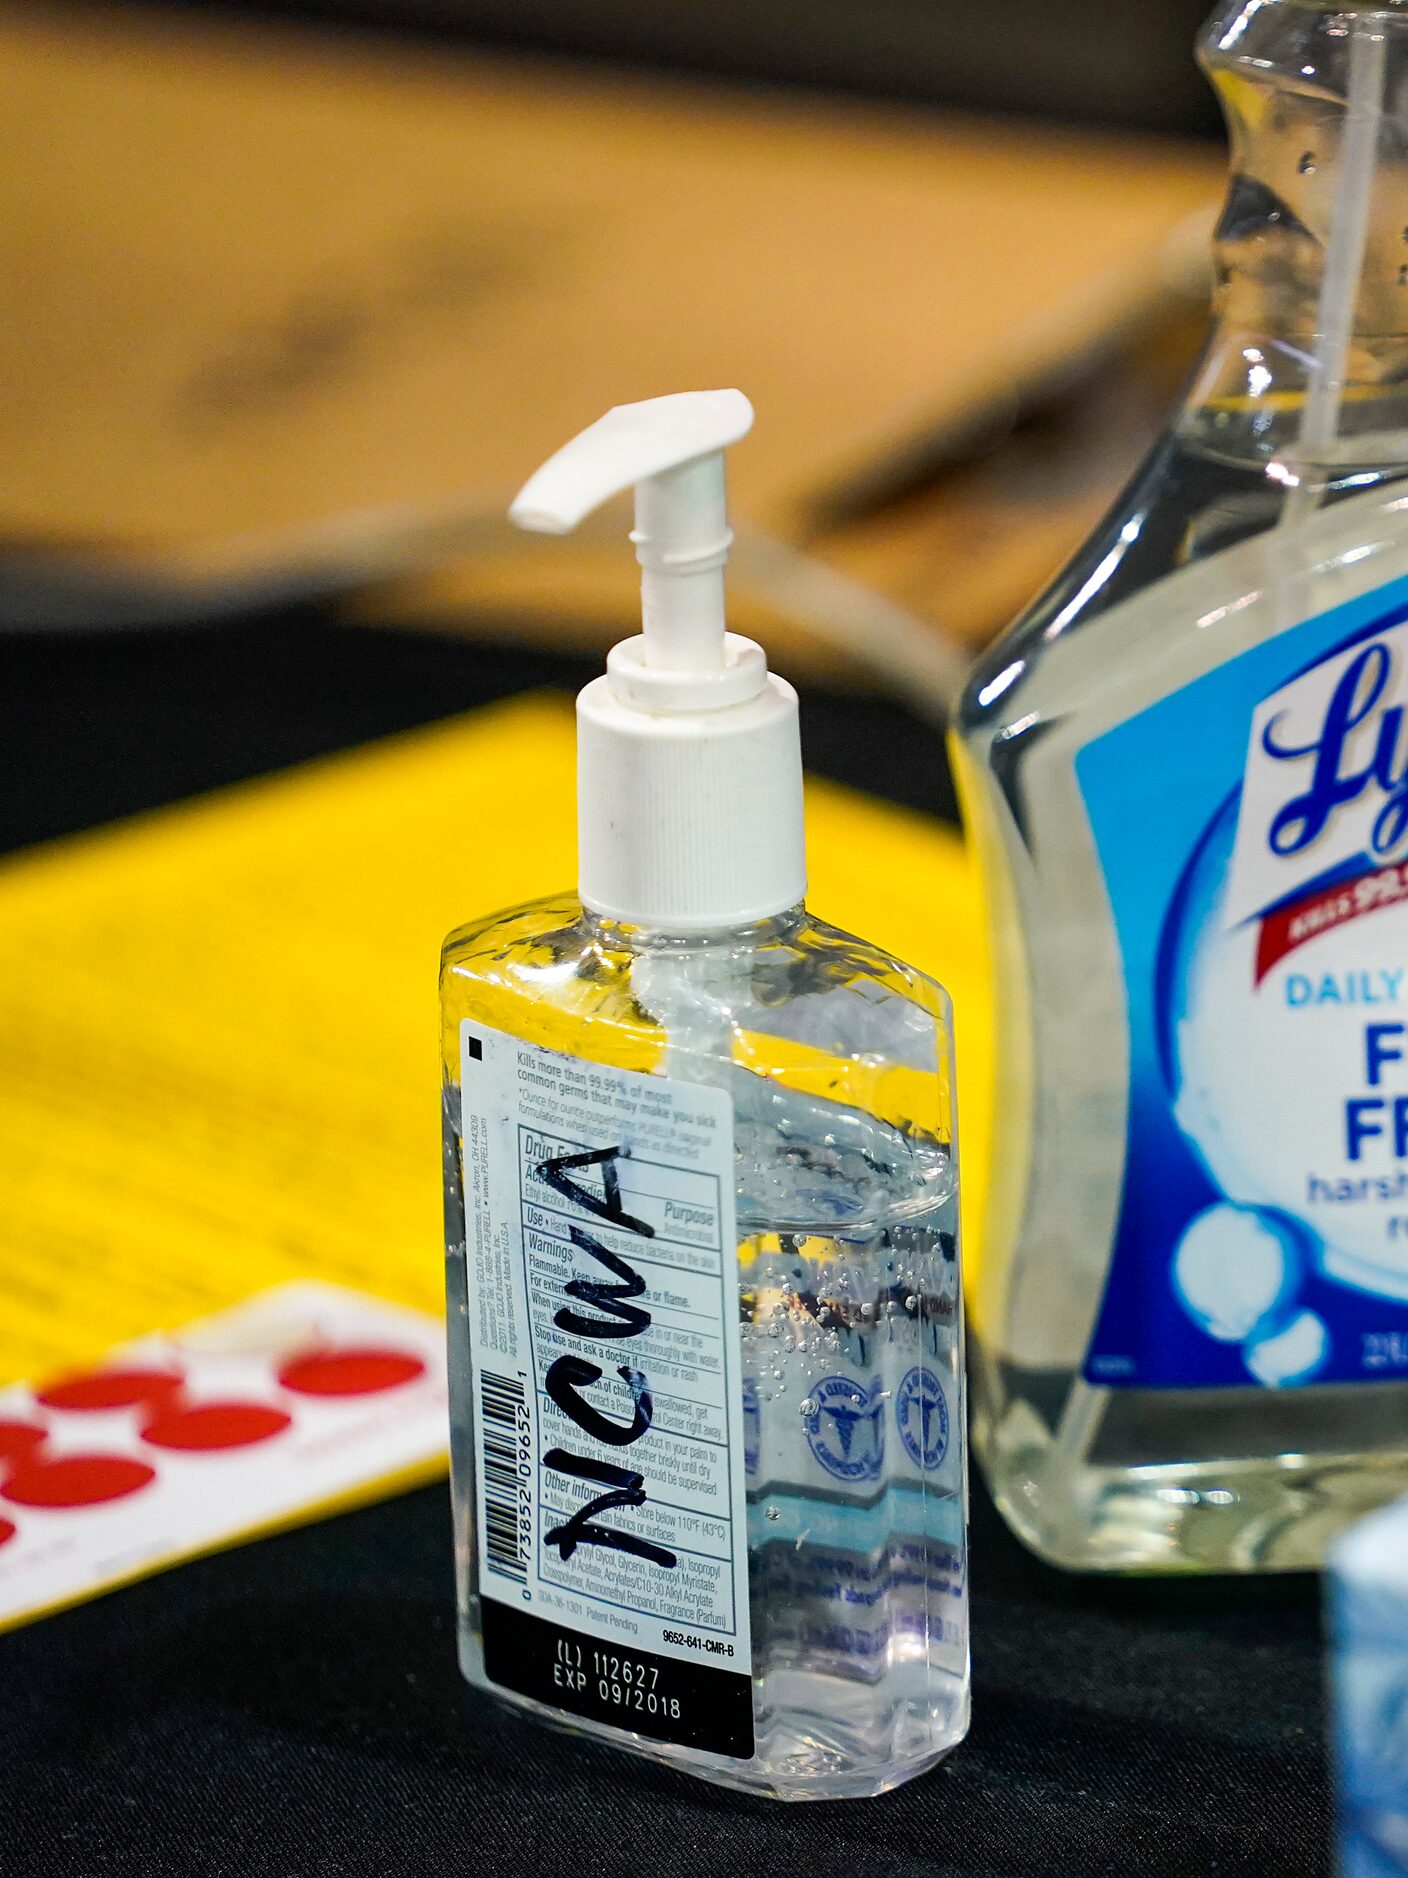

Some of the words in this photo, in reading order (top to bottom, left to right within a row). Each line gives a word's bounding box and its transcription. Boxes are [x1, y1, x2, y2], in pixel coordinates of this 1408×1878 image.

[1285, 966, 1401, 1010] DAILY
[517, 1051, 535, 1069] Kills
[537, 1062, 561, 1078] more
[564, 1067, 585, 1085] than
[631, 1084, 641, 1098] of
[517, 1068, 554, 1089] common
[559, 1081, 588, 1101] germs
[590, 1089, 612, 1106] that
[614, 1096, 636, 1115] may
[640, 1100, 669, 1119] make
[672, 1108, 692, 1127] you
[696, 1111, 715, 1128] sick
[518, 1102, 563, 1126] formulations
[548, 1096, 558, 1111] for
[561, 1102, 584, 1118] ounce
[470, 1114, 478, 1145] 44309
[471, 1147, 479, 1160] OH
[478, 1116, 490, 1198] www.PURELL.com
[526, 1206, 543, 1227] Use
[663, 1200, 714, 1227] Purpose
[528, 1232, 573, 1264] Warnings
[502, 1256, 511, 1281] Made
[528, 1254, 570, 1279] Flammable.
[652, 1289, 662, 1302] or
[530, 1272, 541, 1287] For
[531, 1291, 548, 1307] When
[534, 1325, 551, 1344] Stop
[552, 1331, 565, 1346] use
[567, 1336, 581, 1351] and
[583, 1341, 596, 1356] ask
[598, 1347, 603, 1358] a
[605, 1347, 630, 1366] doctor
[632, 1354, 637, 1367] if
[534, 1144, 677, 1567] NCWA
[516, 1370, 526, 1379] 1
[604, 1380, 611, 1393] of
[585, 1390, 609, 1409] contact
[516, 1403, 532, 1478] 09652
[542, 1417, 560, 1432] cover
[561, 1422, 581, 1439] hands
[629, 1444, 656, 1464] together
[658, 1453, 680, 1473] briskly
[682, 1459, 696, 1475] until
[698, 1464, 710, 1480] dry
[690, 1445, 708, 1464] palm
[709, 1450, 717, 1462] to
[550, 1434, 576, 1453] Children
[577, 1442, 596, 1459] under
[597, 1448, 601, 1461] 6
[602, 1451, 620, 1468] years
[622, 1456, 628, 1469] of
[643, 1464, 665, 1482] should
[667, 1471, 676, 1484] be
[678, 1473, 717, 1497] supervised
[544, 1469, 569, 1493] Other
[635, 1504, 653, 1521] Store
[655, 1510, 675, 1527] below
[678, 1514, 700, 1533] 110°F
[701, 1519, 725, 1542] (43°C)
[550, 1492, 562, 1508] May
[613, 1514, 635, 1532] fabrics
[637, 1522, 643, 1534] or
[646, 1523, 675, 1543] surfaces
[516, 1487, 533, 1562] 73852
[577, 1558, 601, 1578] Acetate,
[603, 1567, 663, 1597] Acrylates/C10-30
[665, 1583, 680, 1601] Alkyl
[682, 1587, 712, 1609] Acrylate
[617, 1555, 646, 1577] Glycerin,
[648, 1564, 680, 1587] Isopropyl
[688, 1557, 721, 1581] Isopropyl
[521, 1588, 531, 1600] 0
[585, 1576, 625, 1601] Aminomethyl
[627, 1589, 657, 1612] Propanol,
[659, 1597, 695, 1621] Fragrance
[696, 1606, 726, 1630] (Parfum)
[586, 1606, 608, 1623] Patent
[610, 1613, 637, 1634] Pending
[662, 1628, 735, 1657] 9652-641-CMR-B
[557, 1638, 582, 1668] (L)
[594, 1651, 660, 1690] 112627
[553, 1663, 587, 1693] EXP
[598, 1678, 681, 1720] 09/2018
